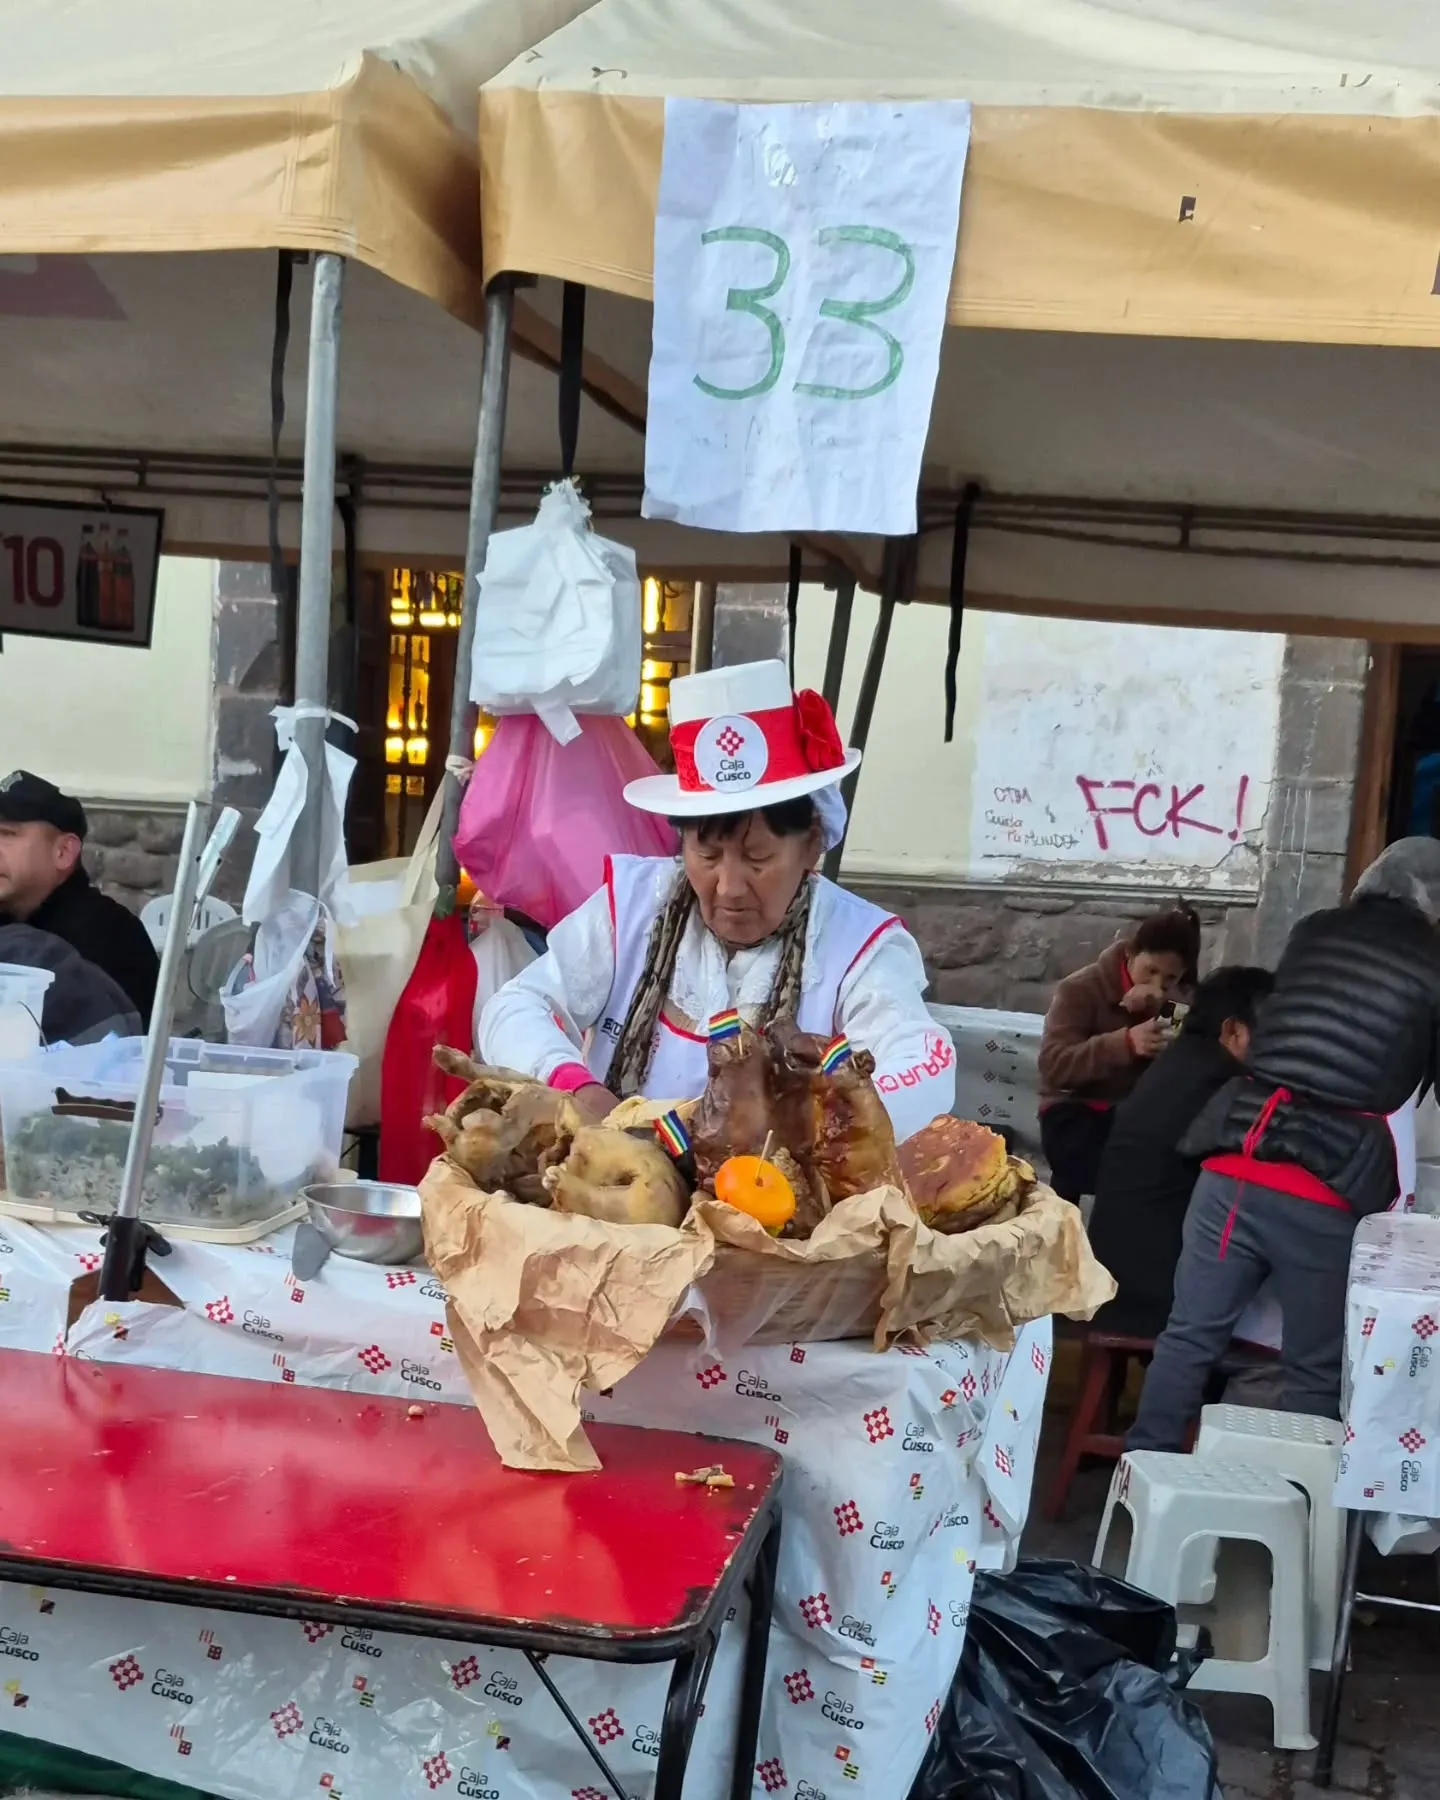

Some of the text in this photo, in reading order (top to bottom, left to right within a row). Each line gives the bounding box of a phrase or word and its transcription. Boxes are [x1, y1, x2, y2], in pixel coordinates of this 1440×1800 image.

[692, 225, 915, 400] 33
[720, 759, 745, 771] Caja
[715, 770, 751, 781] Cusco
[1076, 775, 1249, 850] FCK!
[243, 1310, 271, 1329] Caja
[242, 1323, 284, 1342] Cusco
[401, 1358, 430, 1376] Caja
[400, 1369, 442, 1391] Cusco
[737, 1370, 768, 1390] Caja
[735, 1383, 782, 1402] Cusco
[905, 1422, 925, 1438] Caja
[902, 1438, 934, 1452] Cusco
[1400, 1460, 1411, 1491] Cusco
[874, 1521, 900, 1538] Caja
[870, 1535, 904, 1551] Cusco
[841, 1615, 872, 1635] Caja
[0, 1626, 29, 1645] Caja
[341, 1635, 383, 1658] Cusco
[155, 1668, 184, 1687] Caja
[490, 1671, 519, 1690] Caja
[151, 1682, 194, 1705] Cusco
[484, 1684, 523, 1706] Cusco
[824, 1691, 854, 1715] Caja
[313, 1717, 342, 1737] Caja
[821, 1705, 864, 1730] Cusco
[309, 1731, 350, 1754] Cusco
[632, 1738, 659, 1757] Cus
[460, 1766, 488, 1786] Caja
[457, 1781, 499, 1800] Cusco
[797, 1780, 826, 1800] Caja
